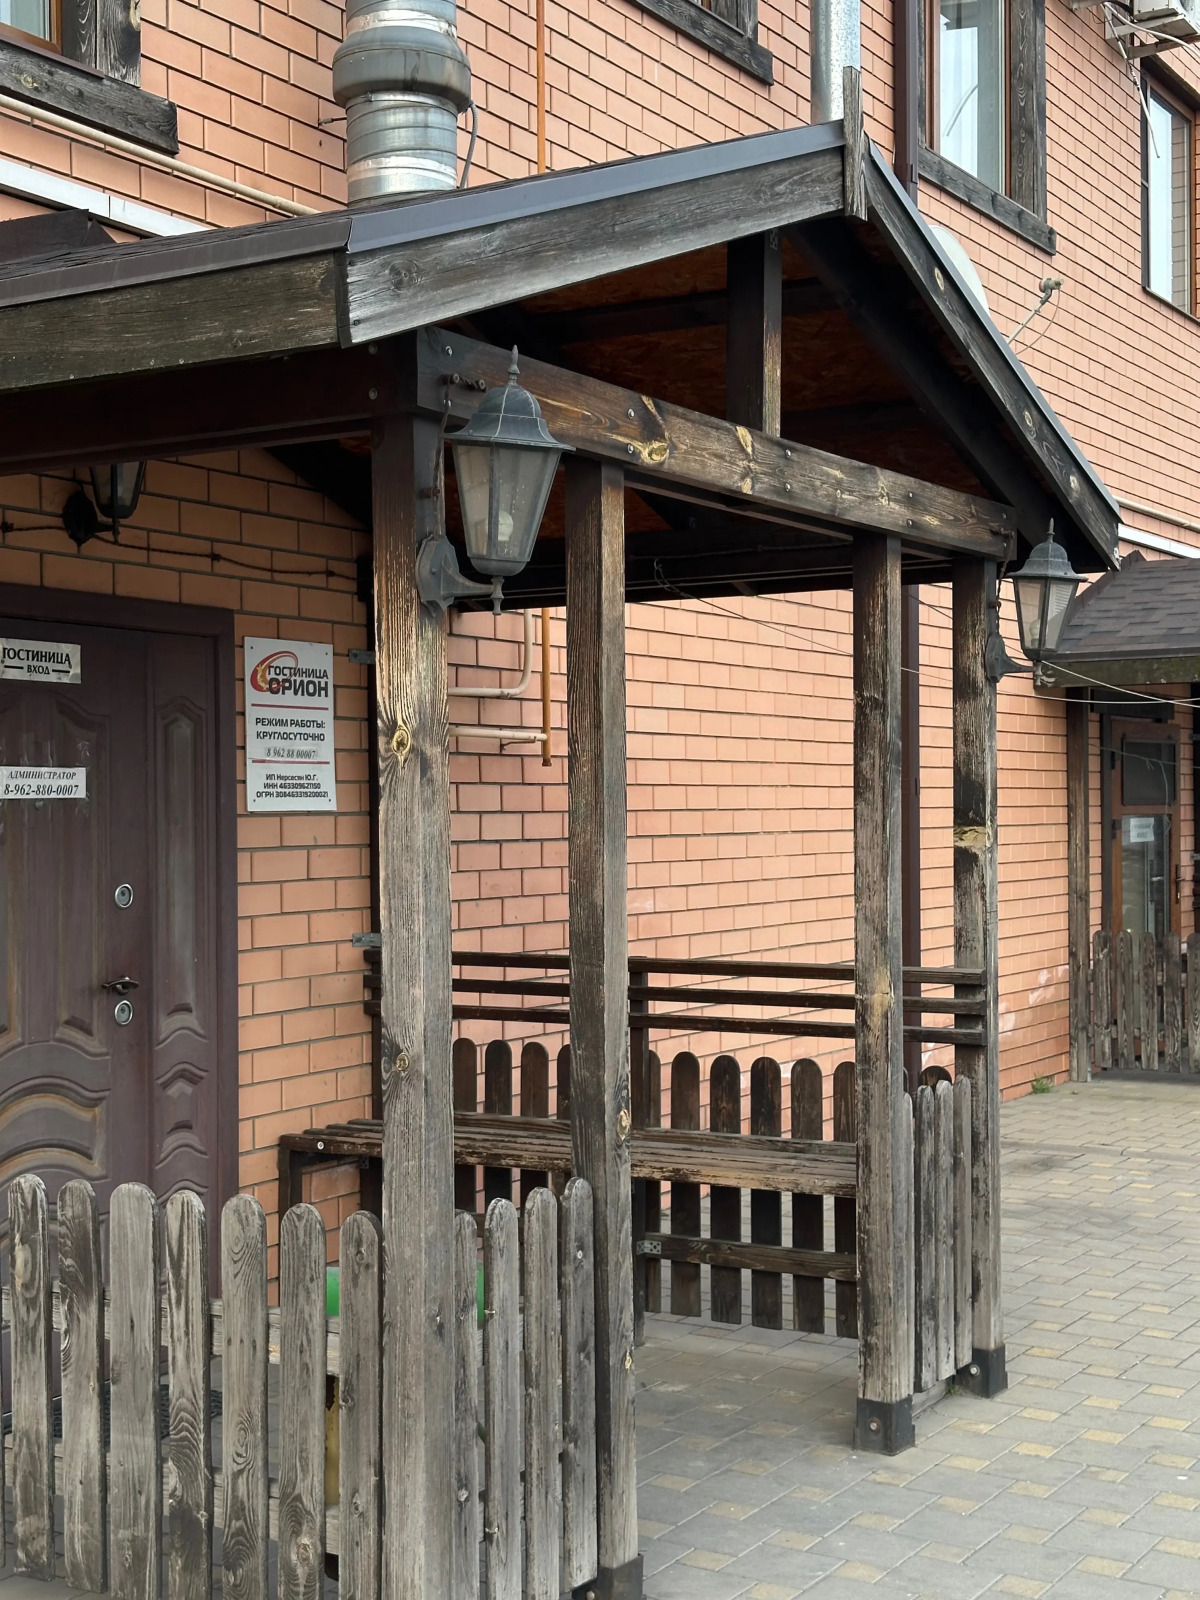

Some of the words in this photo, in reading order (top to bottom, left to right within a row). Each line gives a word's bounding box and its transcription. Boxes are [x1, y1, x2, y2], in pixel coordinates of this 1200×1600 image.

[2, 647, 72, 668] ГОСТИНИЦА
[27, 665, 50, 675] ВХОД
[268, 666, 329, 679] ГОСТИНИЦА
[268, 678, 328, 698] ОРИОН
[255, 717, 288, 727] РЕЖИМ
[290, 719, 326, 729] РАБОТЫ:
[256, 731, 325, 741] КРУГЛОСУТОЧНО
[266, 748, 271, 757] 8
[273, 748, 285, 758] 962
[7, 771, 77, 780] АДМИНИСТРАТОР
[4, 784, 79, 796] 8-962-880-0007
